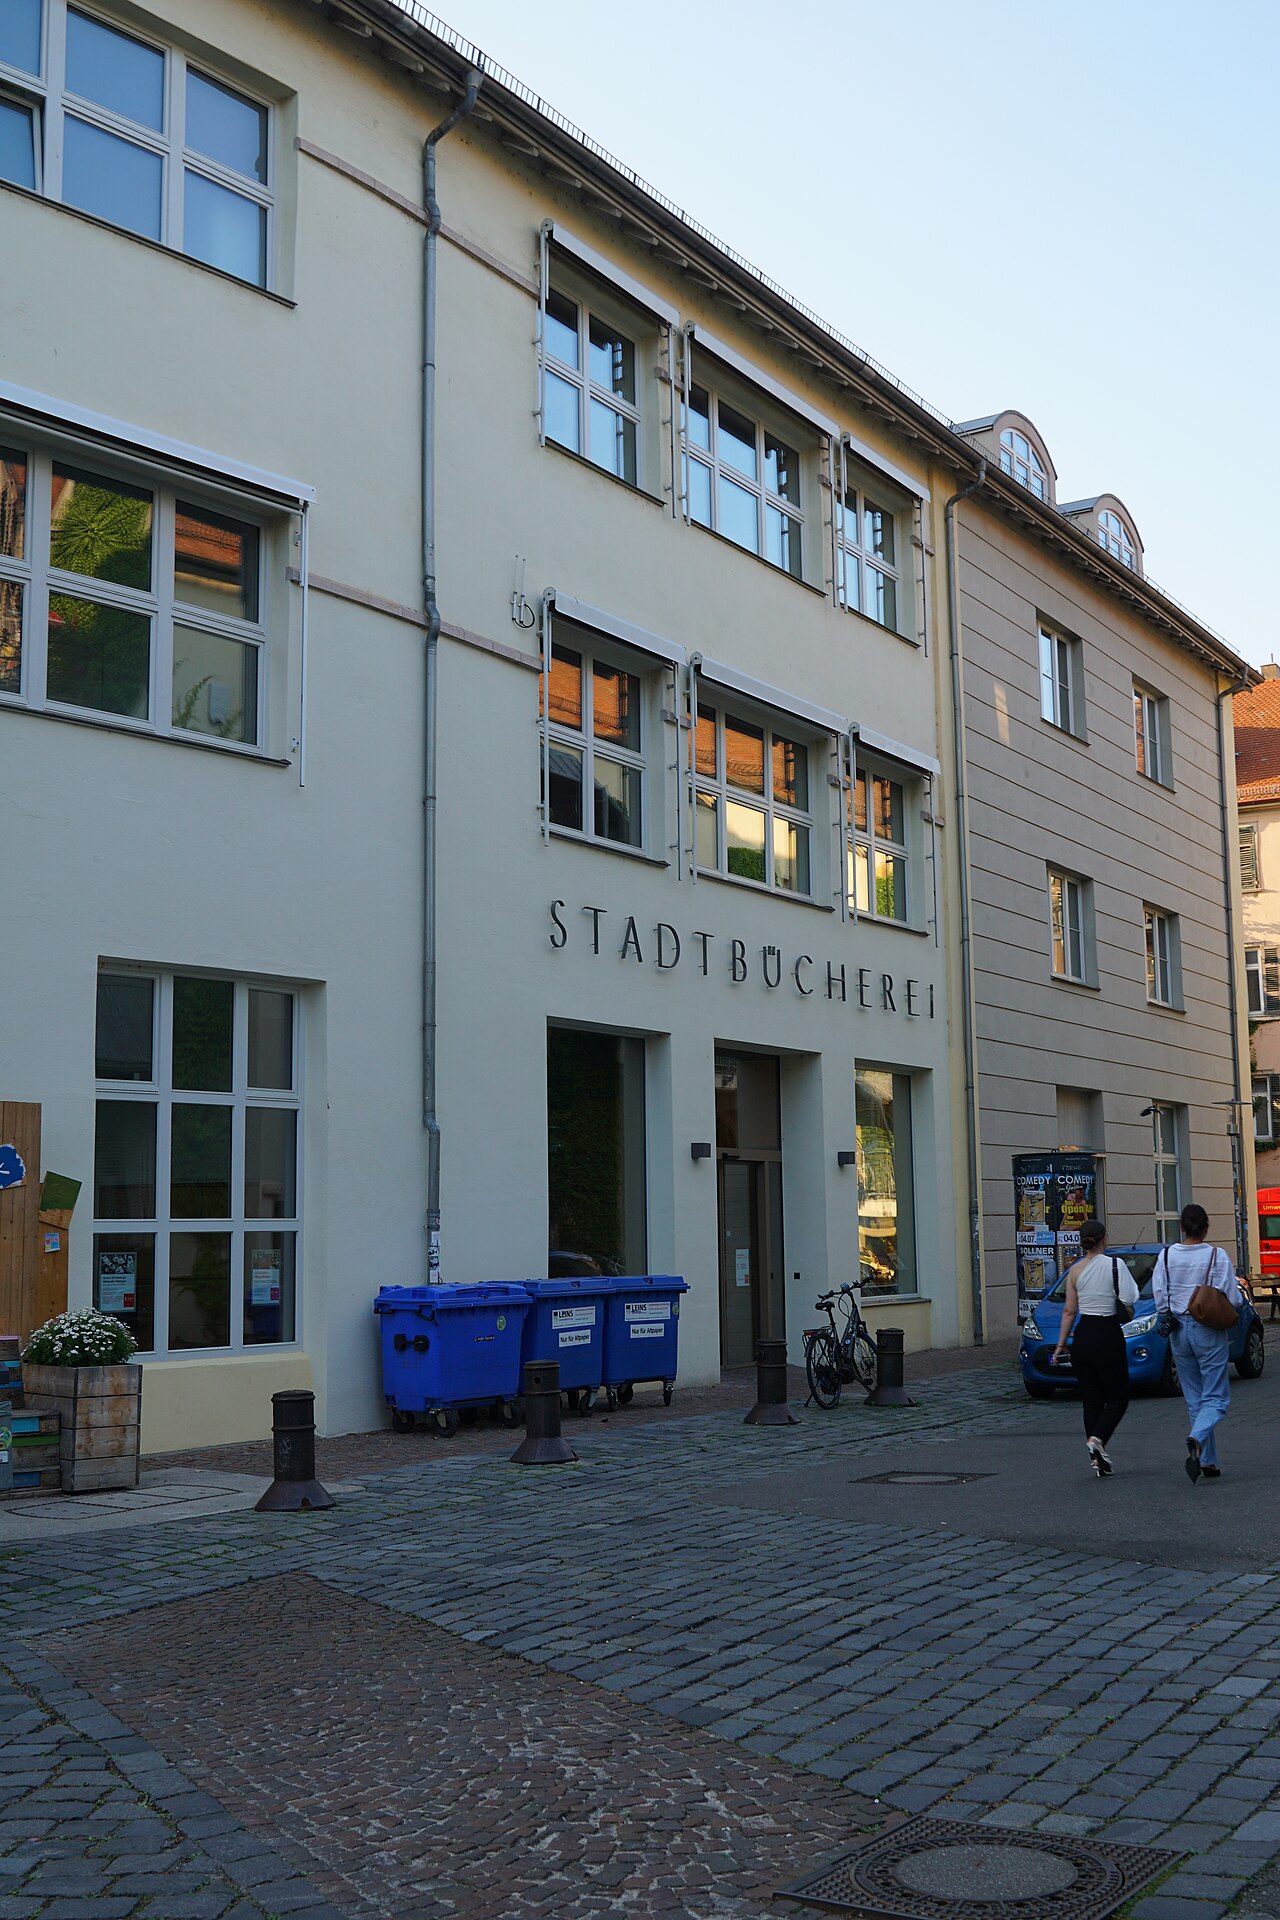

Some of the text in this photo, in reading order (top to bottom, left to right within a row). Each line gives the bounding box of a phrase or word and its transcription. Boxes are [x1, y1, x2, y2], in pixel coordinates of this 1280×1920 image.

[549, 899, 934, 1019] STADTBÜCHEREI
[1017, 1175, 1051, 1186] COMEDY
[1057, 1175, 1094, 1185] COMEDY
[1061, 1204, 1084, 1214] Open
